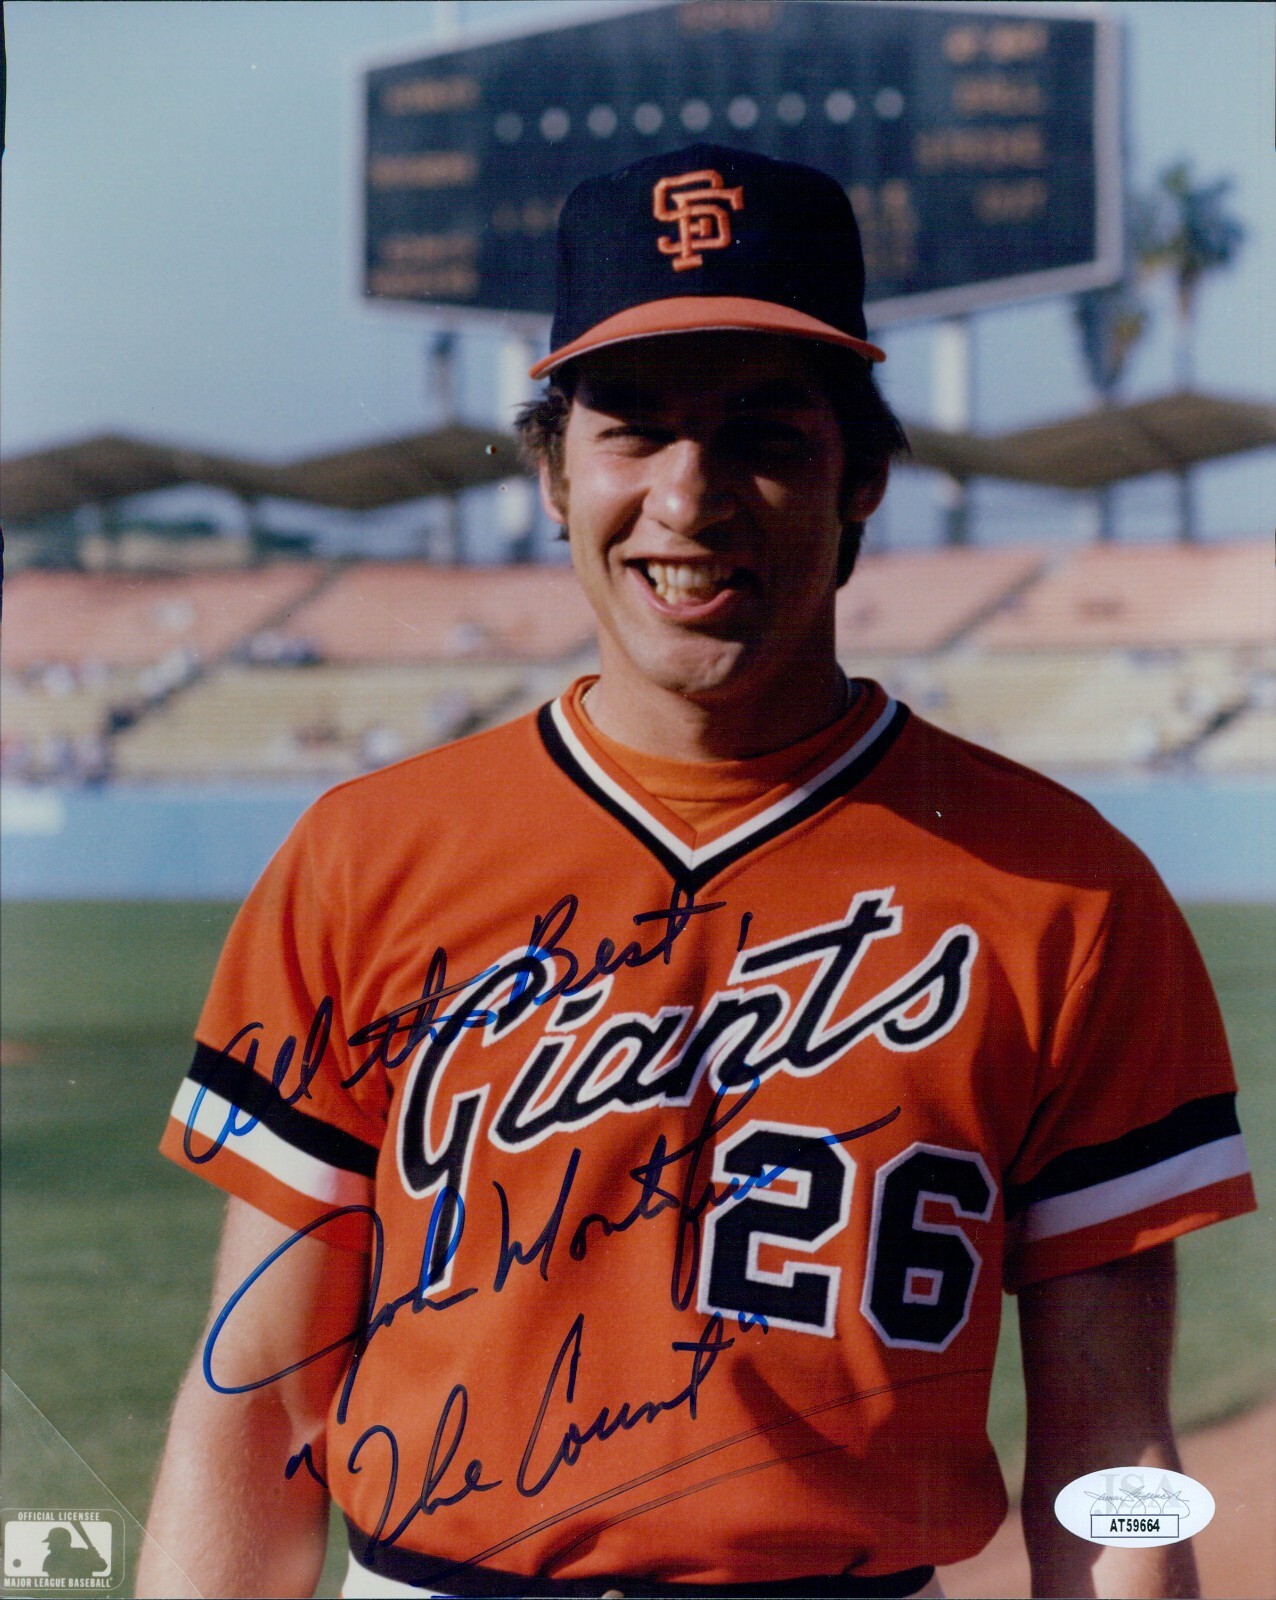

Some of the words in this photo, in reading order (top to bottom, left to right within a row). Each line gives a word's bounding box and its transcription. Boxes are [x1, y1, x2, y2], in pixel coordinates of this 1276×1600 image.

[653, 169, 744, 272] SF
[183, 995, 334, 1165] All
[397, 885, 979, 1298] Giants
[696, 1119, 999, 1353] 26
